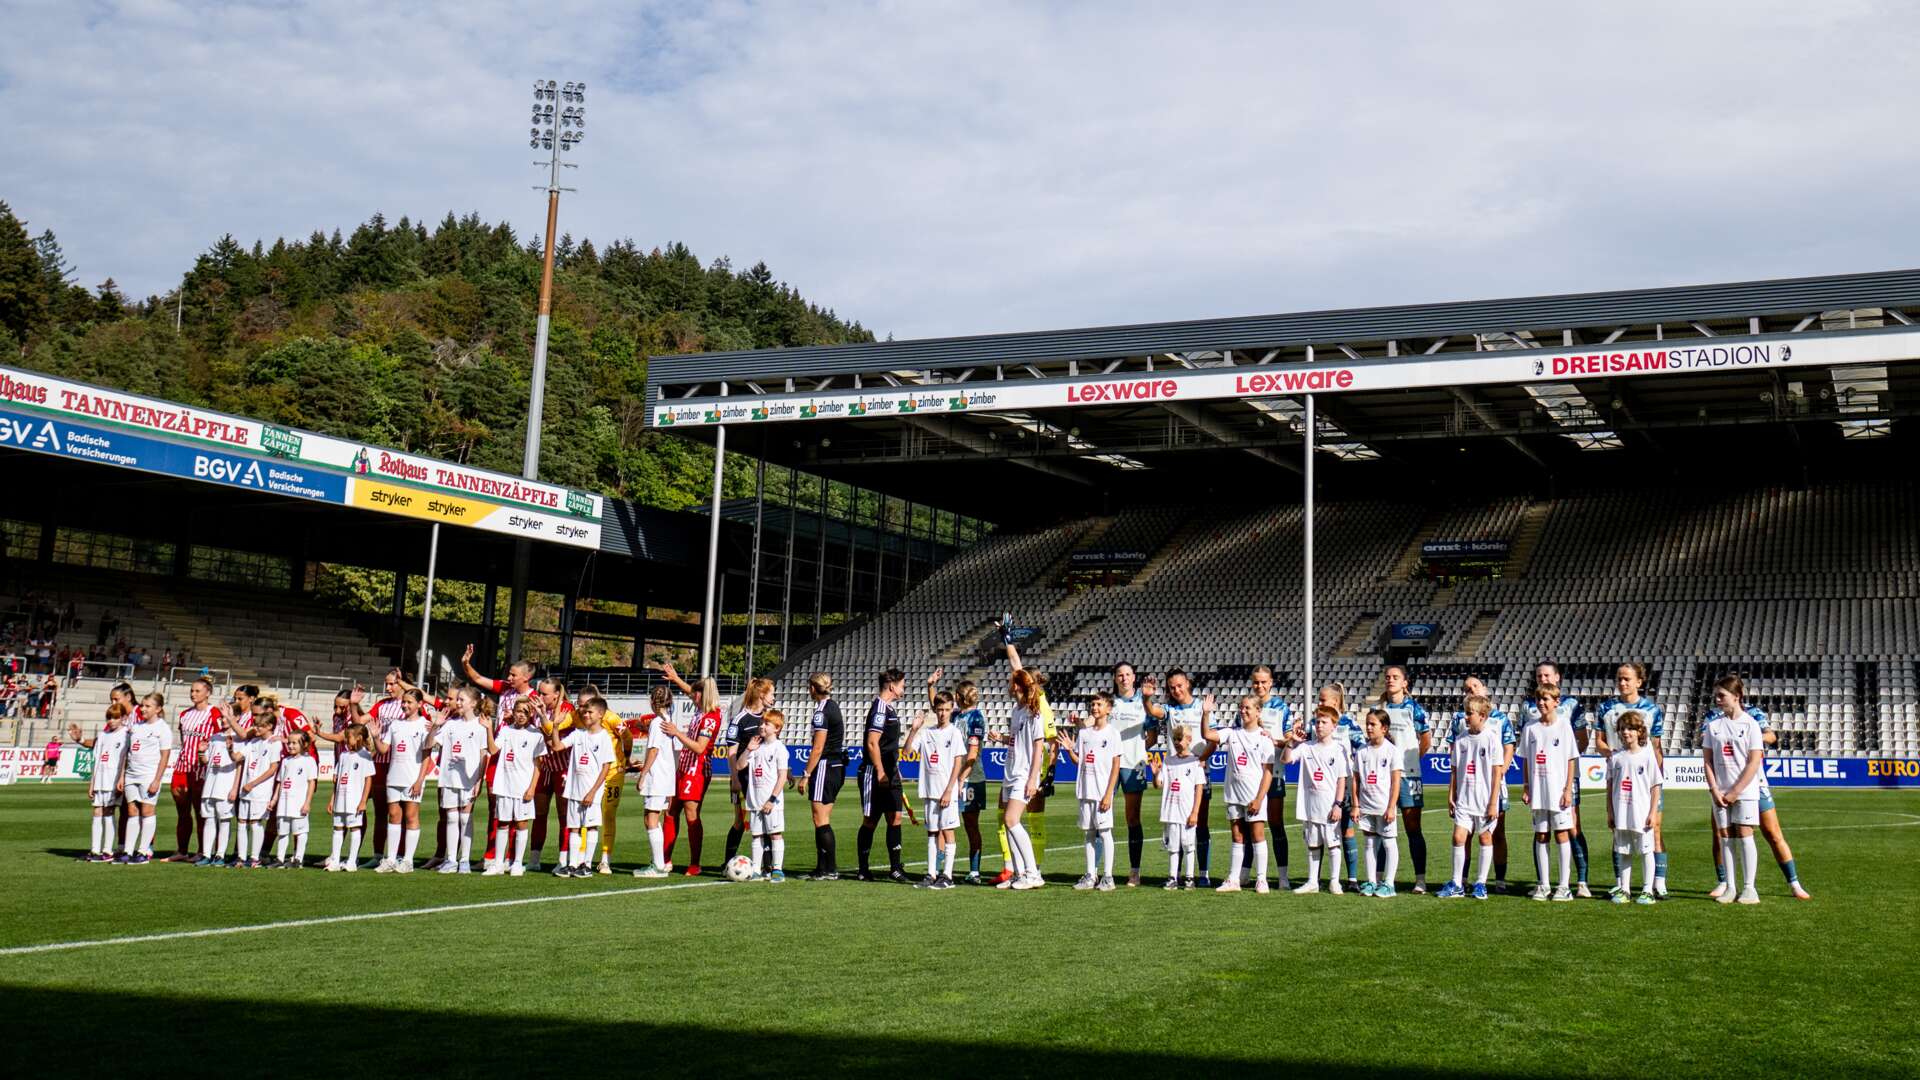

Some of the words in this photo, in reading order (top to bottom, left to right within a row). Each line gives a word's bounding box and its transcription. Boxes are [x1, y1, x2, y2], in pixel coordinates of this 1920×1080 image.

[1552, 345, 1770, 375] DREISAMSTADION
[867, 397, 893, 410] zimber
[918, 395, 944, 408] zimber
[968, 392, 996, 405] zimber
[676, 407, 700, 420] zimber
[722, 405, 747, 418] zimber
[770, 402, 795, 415] zimber
[818, 400, 844, 413] zimber
[61, 390, 249, 445] TANNENZÄPFLE
[67, 431, 110, 449] Badische
[264, 426, 301, 445] TANNEN
[263, 435, 298, 455] ZÄPFLE
[66, 443, 137, 465] Versicherungen
[194, 455, 242, 482] BGV
[269, 469, 303, 483] Badische
[379, 451, 428, 481] Rothaus
[437, 469, 558, 508] TANNENZÄPFLE
[268, 480, 325, 498] Versicherungen
[370, 490, 412, 509] stryker
[568, 491, 594, 505] TANNEN
[427, 499, 466, 518] stryker
[508, 515, 543, 531] stryker
[556, 524, 588, 539] stryker
[606, 786, 620, 799] 38
[684, 780, 692, 794] 2
